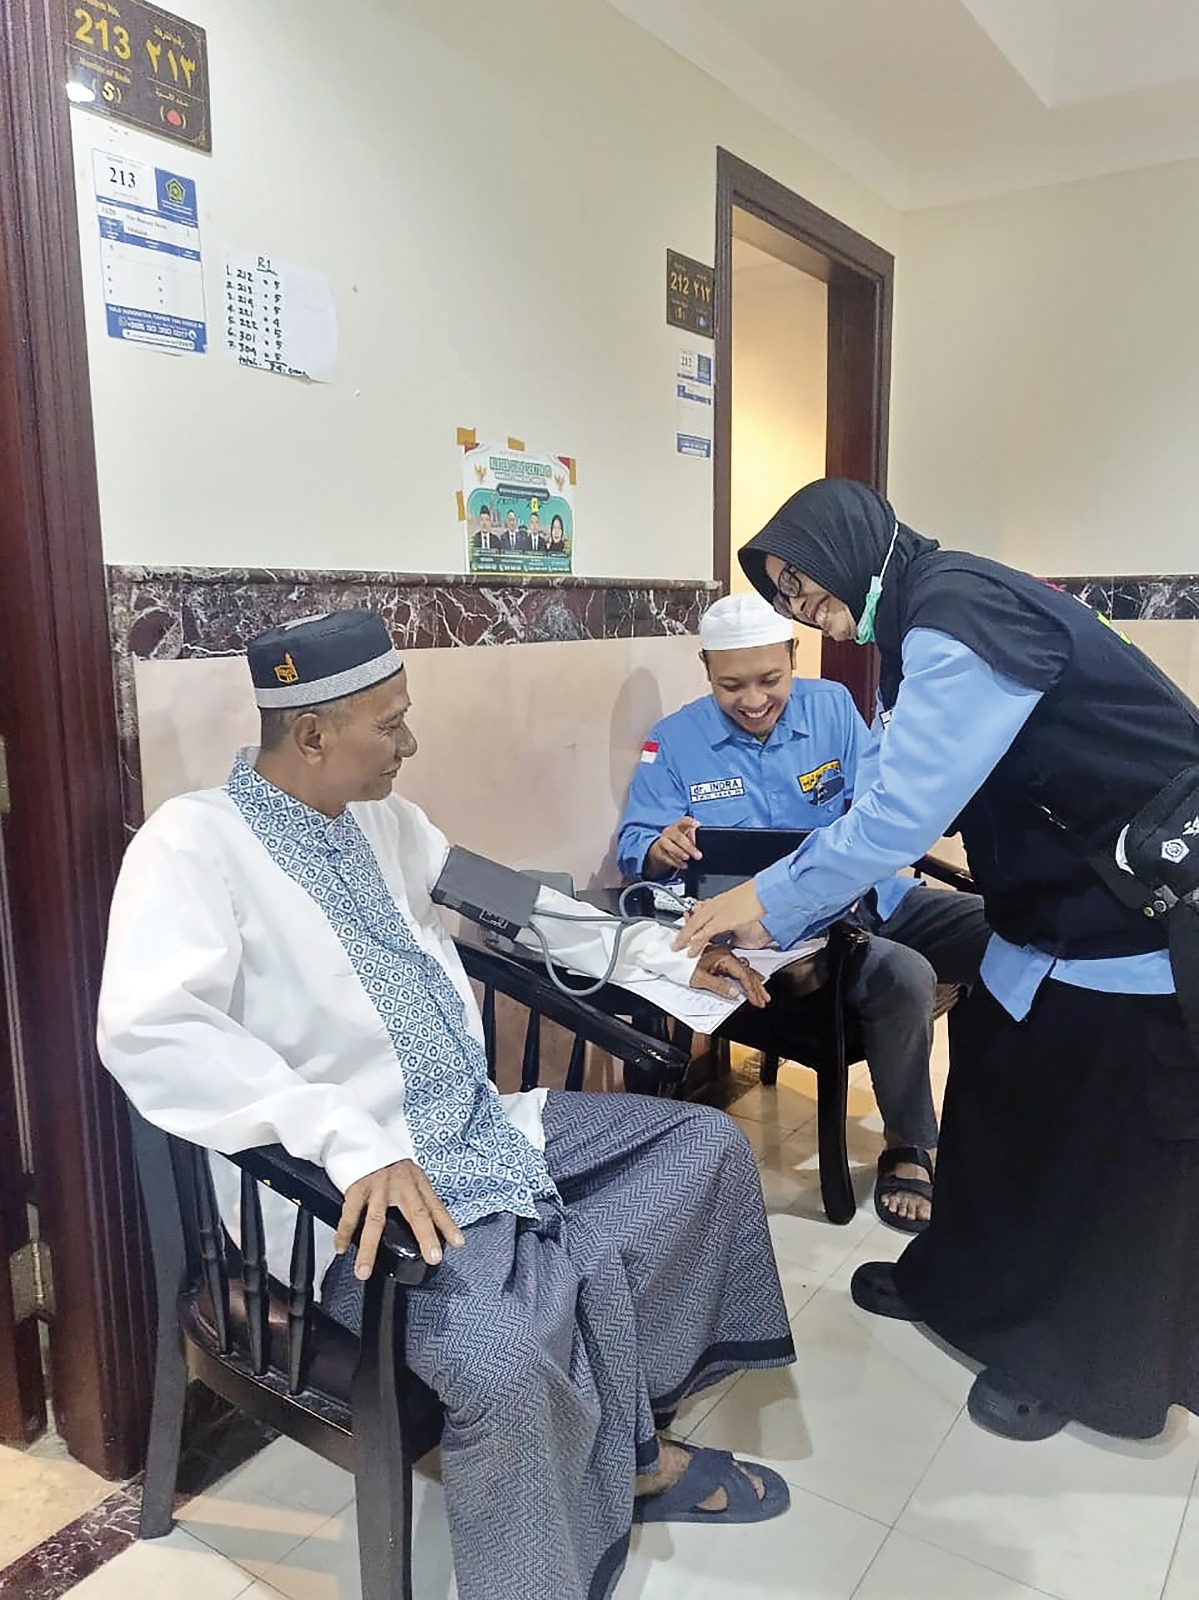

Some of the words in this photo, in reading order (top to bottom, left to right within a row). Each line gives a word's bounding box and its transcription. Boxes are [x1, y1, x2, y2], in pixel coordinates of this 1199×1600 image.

[74, 8, 131, 60] 213
[109, 166, 136, 189] 213
[257, 256, 271, 269] R1
[237, 269, 254, 282] 212
[671, 271, 689, 296] 212
[274, 294, 282, 303] 5
[239, 318, 259, 331] 222
[274, 329, 282, 338] 5
[239, 330, 256, 343] 301
[276, 340, 282, 350] 5
[710, 779, 739, 791] INDRA
